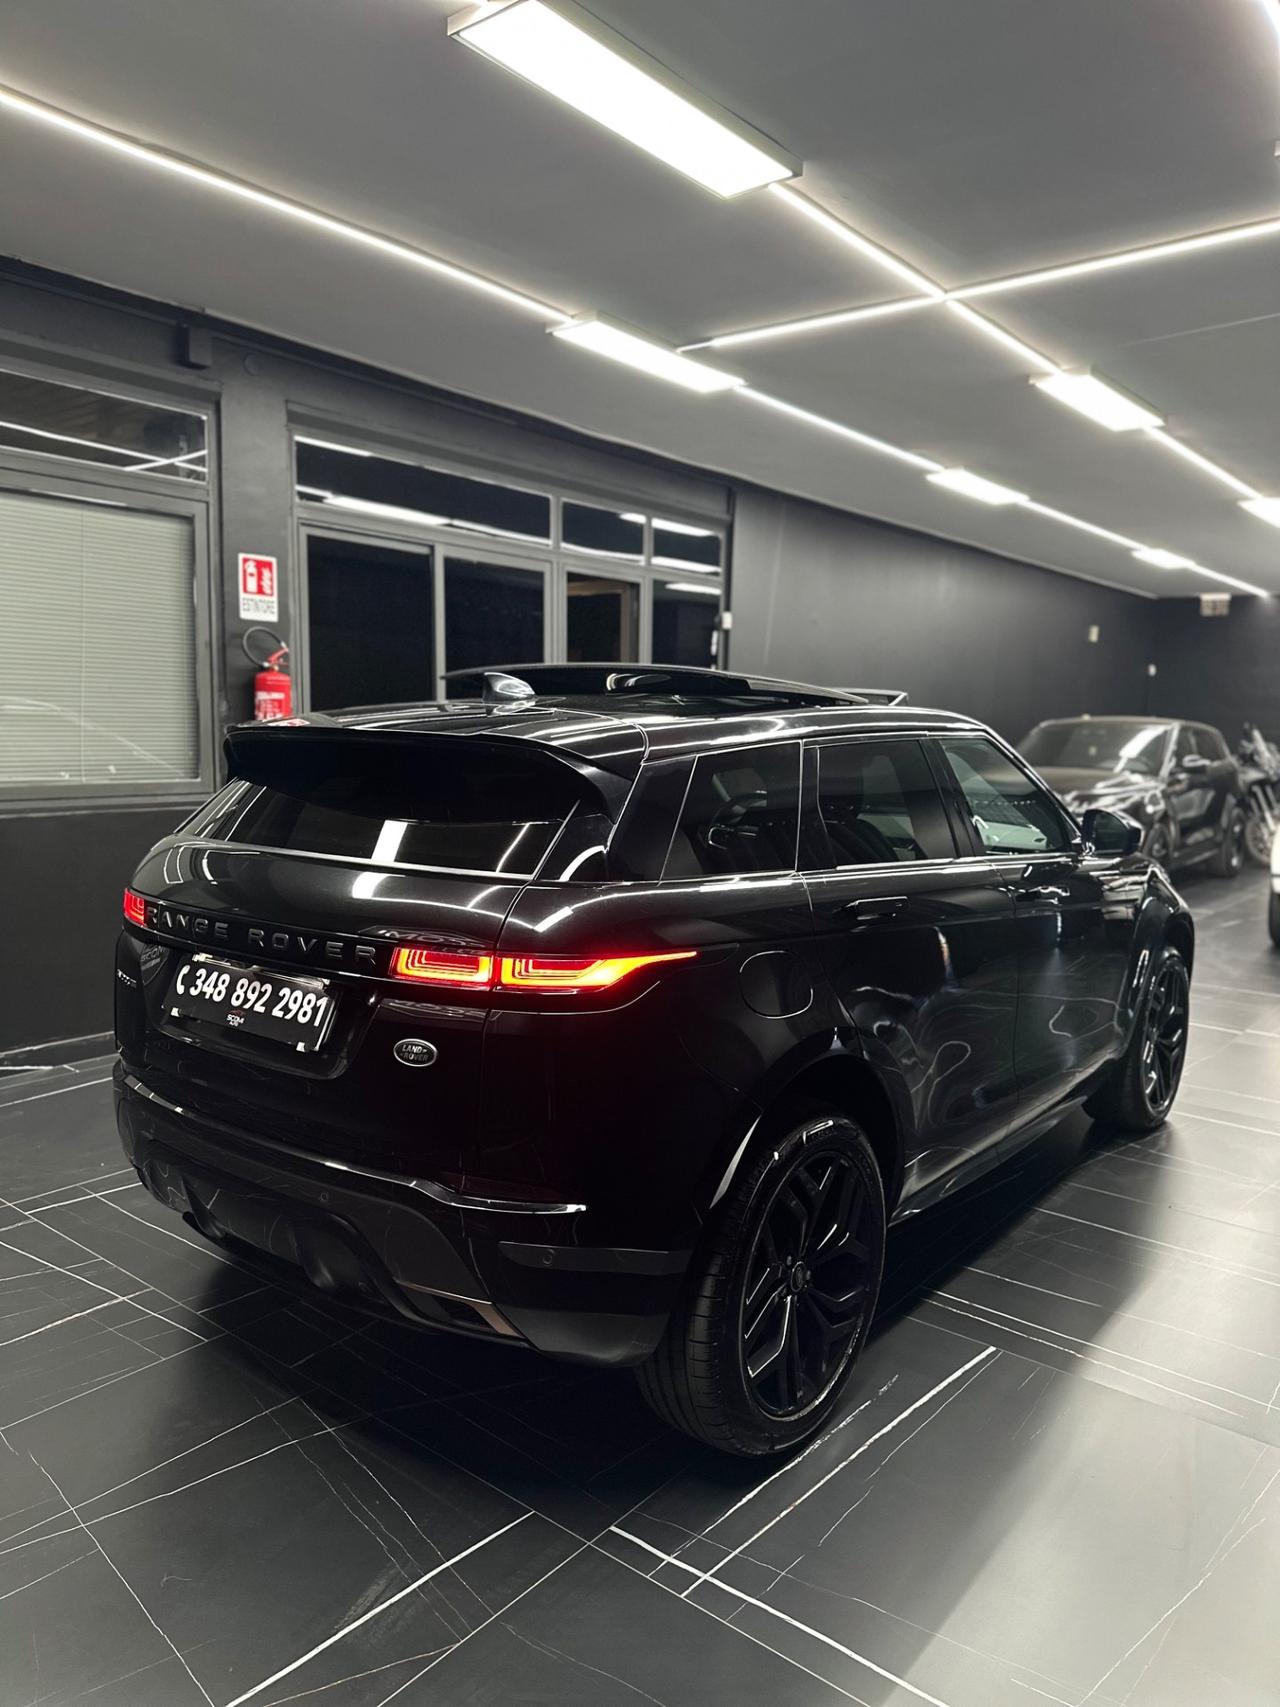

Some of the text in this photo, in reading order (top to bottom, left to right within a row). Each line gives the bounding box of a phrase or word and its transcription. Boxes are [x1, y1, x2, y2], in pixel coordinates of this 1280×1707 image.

[146, 906, 376, 965] RANGE ROVER
[189, 968, 329, 1027] 348 892 2981
[401, 1044, 423, 1053] LAND
[403, 1052, 428, 1061] ROVER
